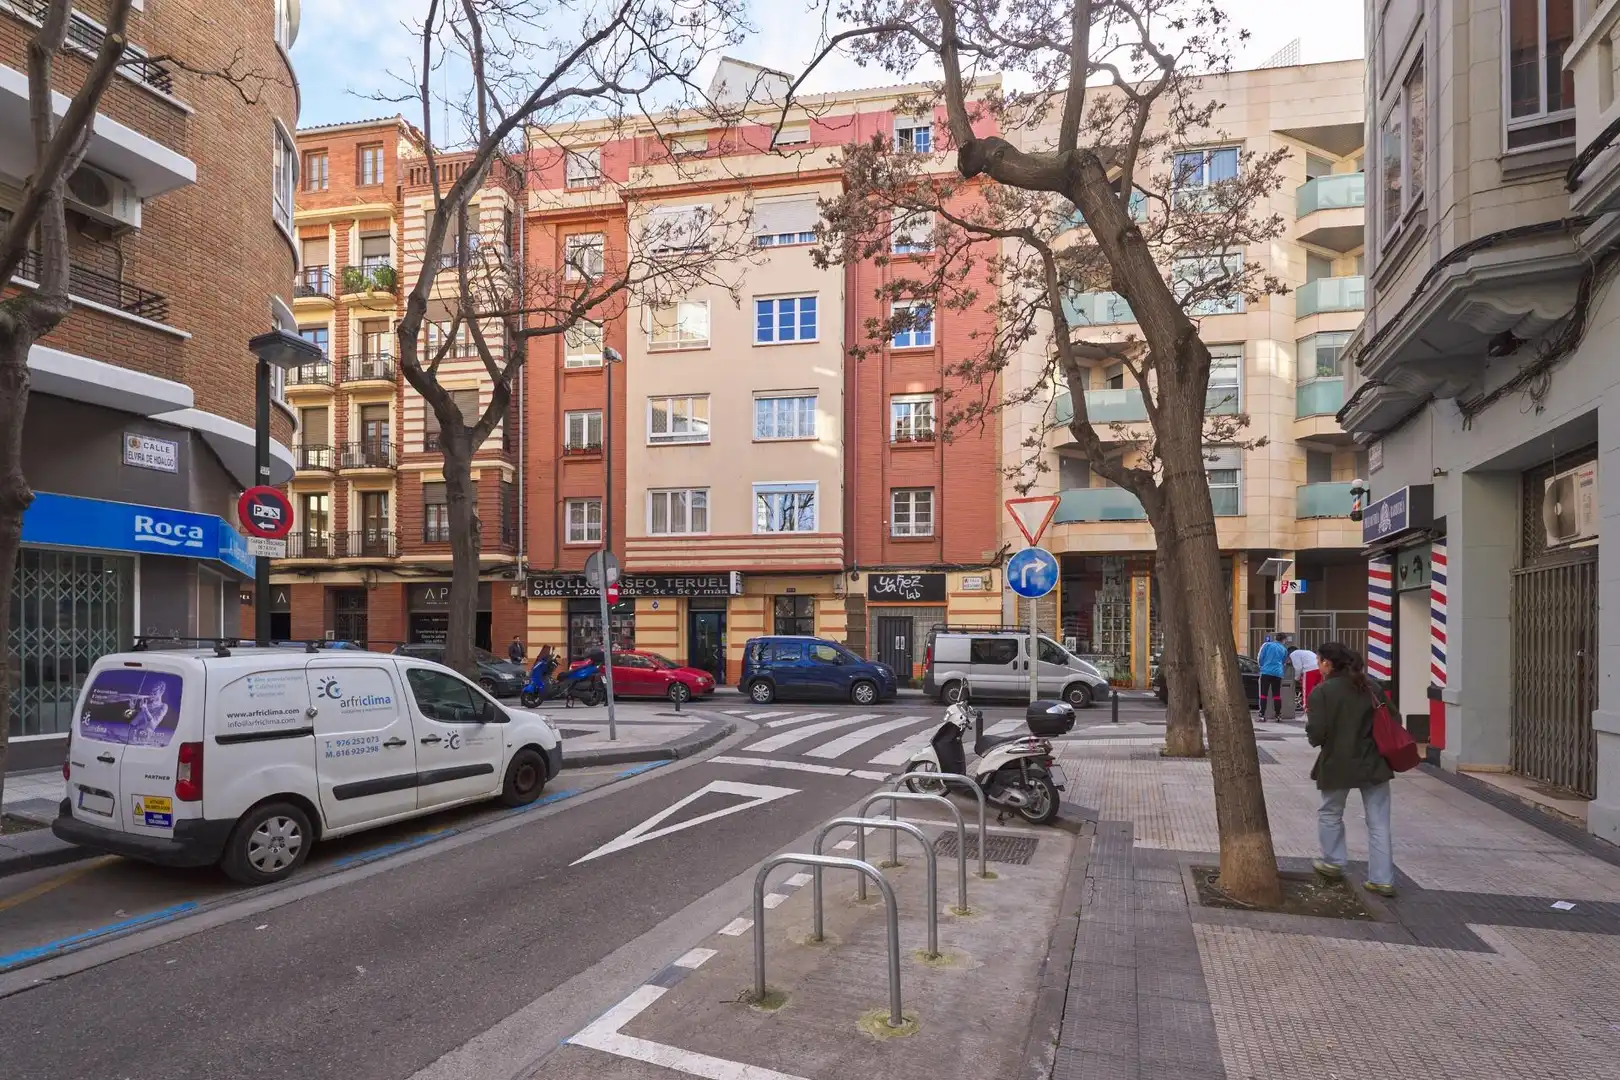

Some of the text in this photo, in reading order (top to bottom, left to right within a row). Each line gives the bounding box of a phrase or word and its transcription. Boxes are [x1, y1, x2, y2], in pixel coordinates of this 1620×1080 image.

[143, 442, 171, 454] CALLE
[128, 450, 145, 461] ELVIRA
[146, 453, 153, 464] DE
[135, 515, 204, 539] Roca
[616, 578, 657, 588] ASEO
[665, 578, 728, 588] TERUEL
[534, 588, 563, 596] 0,60€
[619, 588, 642, 596] ,80€
[704, 587, 728, 595] más
[906, 588, 921, 600] lab
[340, 695, 392, 708] arfriclima
[226, 707, 300, 718] www.arfriclima.com
[227, 717, 296, 728] info@arfriclima.com
[325, 735, 380, 749] T. 976 252 073
[351, 747, 365, 756] 929
[366, 745, 379, 754] 298
